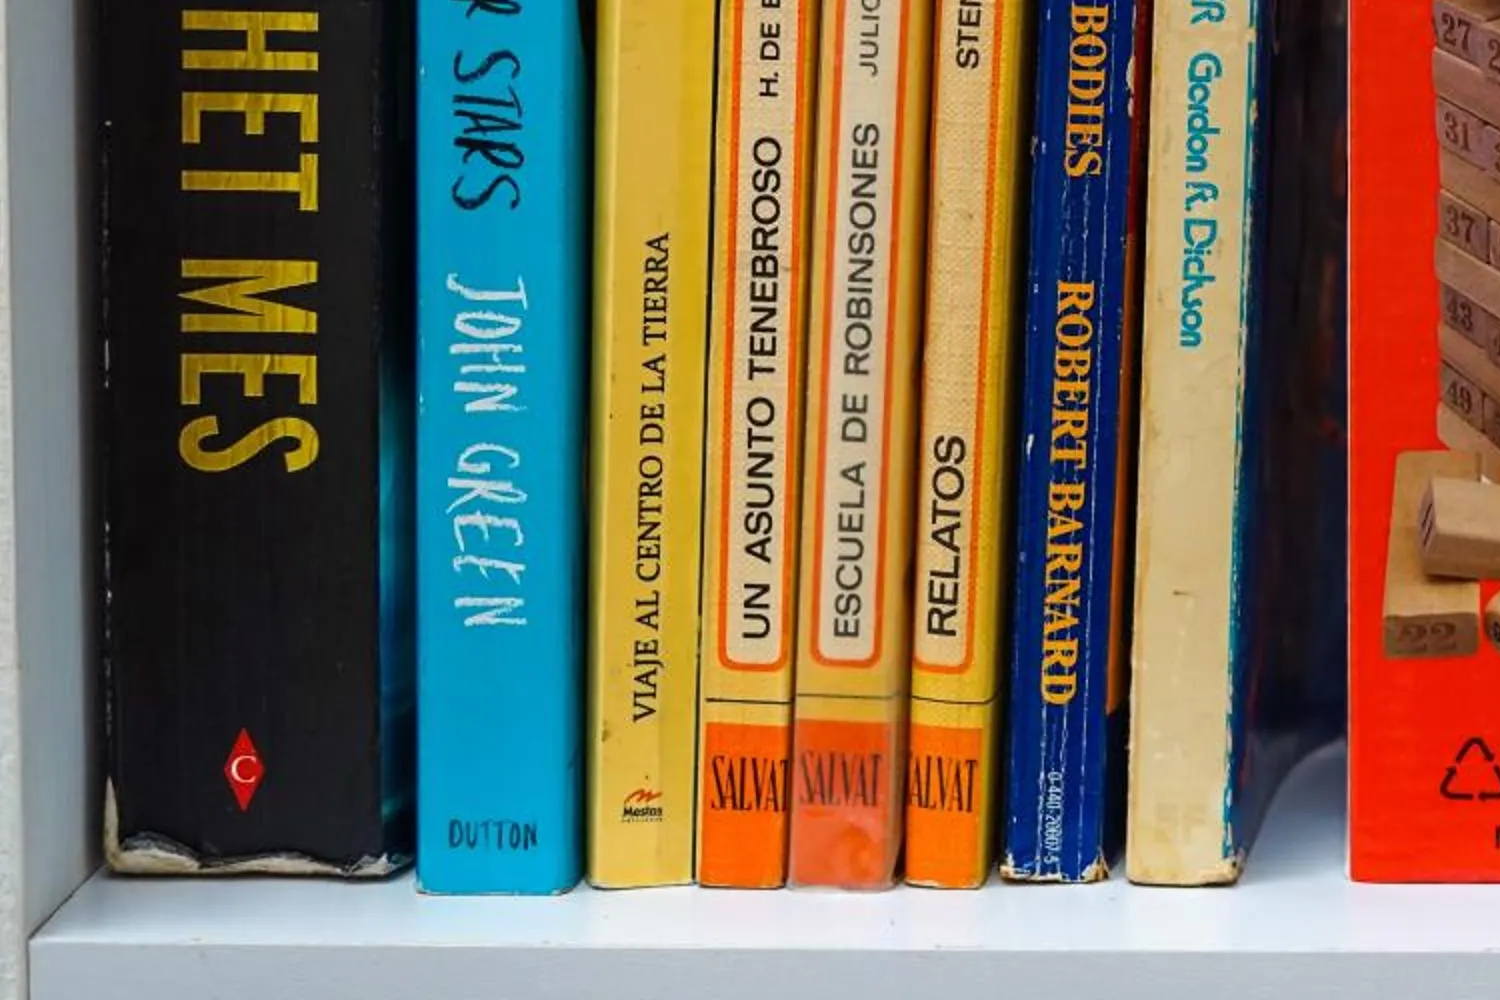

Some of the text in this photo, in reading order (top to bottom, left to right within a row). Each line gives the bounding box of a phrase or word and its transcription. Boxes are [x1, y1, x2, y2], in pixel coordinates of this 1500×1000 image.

[759, 71, 779, 99] H.
[760, 26, 782, 63] DE
[1442, 13, 1471, 52] 27
[454, 49, 526, 212] STARS
[1064, 3, 1109, 177] BODIES
[1444, 113, 1472, 152] 31
[177, 9, 320, 474] HET MES
[1179, 52, 1223, 348] Gordon R. Dickson
[1446, 205, 1476, 244] 37
[743, 134, 784, 640] UN ASUNTO TENEBROSO
[834, 122, 880, 638] ESCUELA DE ROBINSONES
[446, 272, 527, 628] JOHN GREEN
[632, 232, 671, 723] VIAJE AL CENTRO DE LA TIERRA
[1039, 279, 1094, 705] ROBERT BARNARD
[928, 434, 967, 638] RELATOS
[1402, 622, 1458, 652] 22
[230, 757, 262, 785] C
[800, 751, 883, 807] SALVAT
[908, 754, 977, 813] ALVAT
[448, 819, 539, 852] DUTTON
